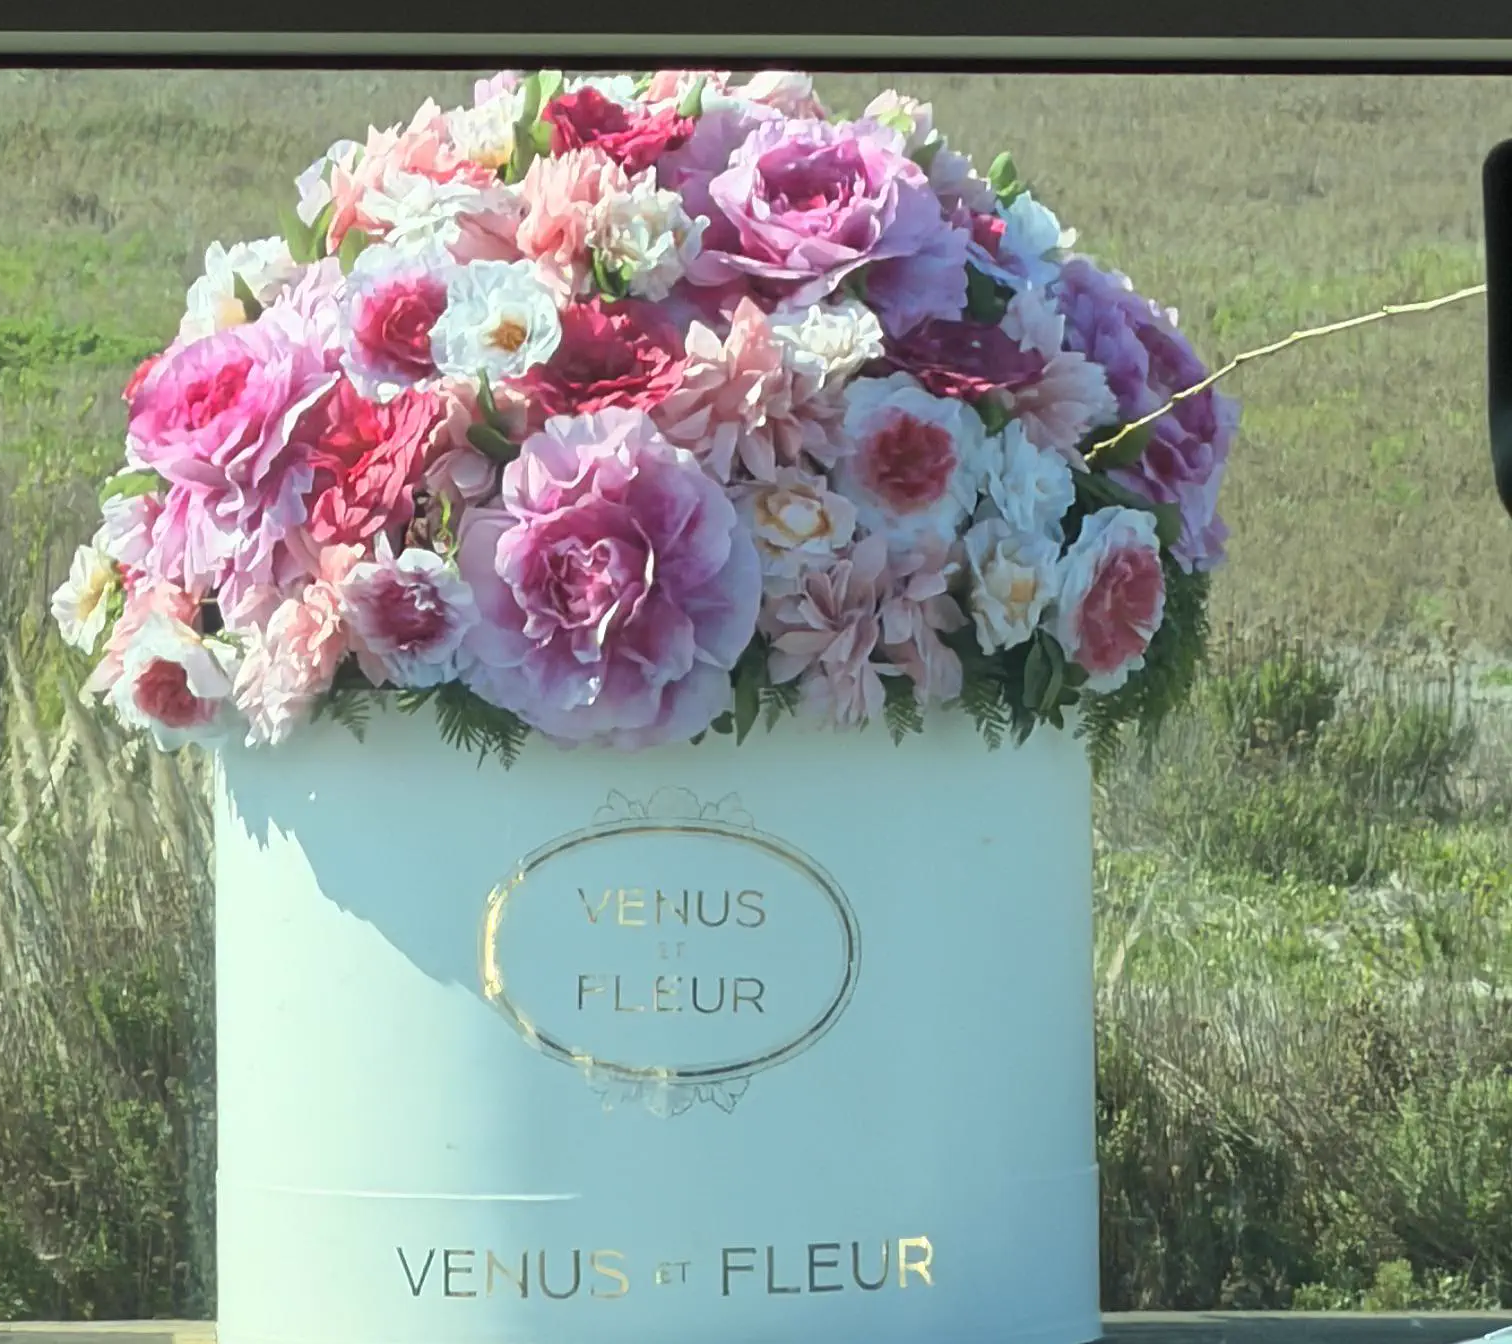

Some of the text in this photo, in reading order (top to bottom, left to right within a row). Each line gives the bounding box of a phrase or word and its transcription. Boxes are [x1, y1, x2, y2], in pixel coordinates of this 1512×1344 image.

[576, 887, 766, 928] VENUS
[577, 973, 766, 1014] FLEUR
[396, 1235, 934, 1300] VENUS ET FLEUR
